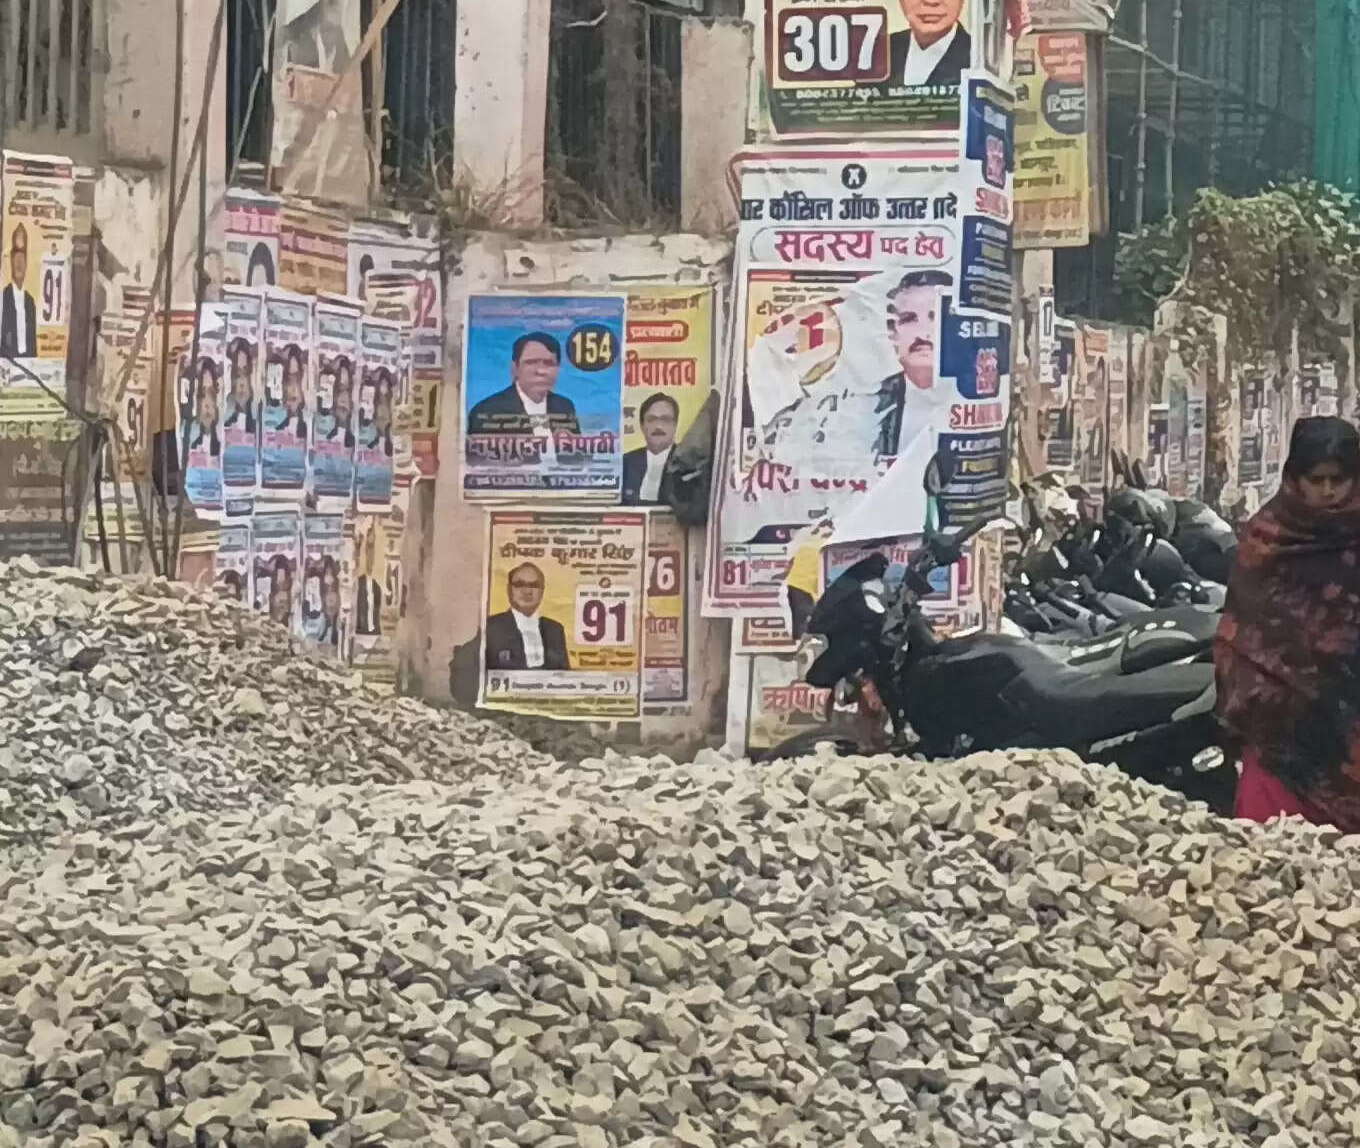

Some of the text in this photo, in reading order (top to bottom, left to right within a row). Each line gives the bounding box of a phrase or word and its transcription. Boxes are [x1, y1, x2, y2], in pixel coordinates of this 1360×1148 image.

[783, 13, 885, 73] 307
[933, 191, 959, 220] प्रदे
[773, 229, 876, 263] सदस्य
[880, 237, 909, 256] पद
[42, 268, 64, 323] 91
[571, 331, 614, 365] 154
[722, 559, 748, 587] 81
[581, 599, 627, 643] 91
